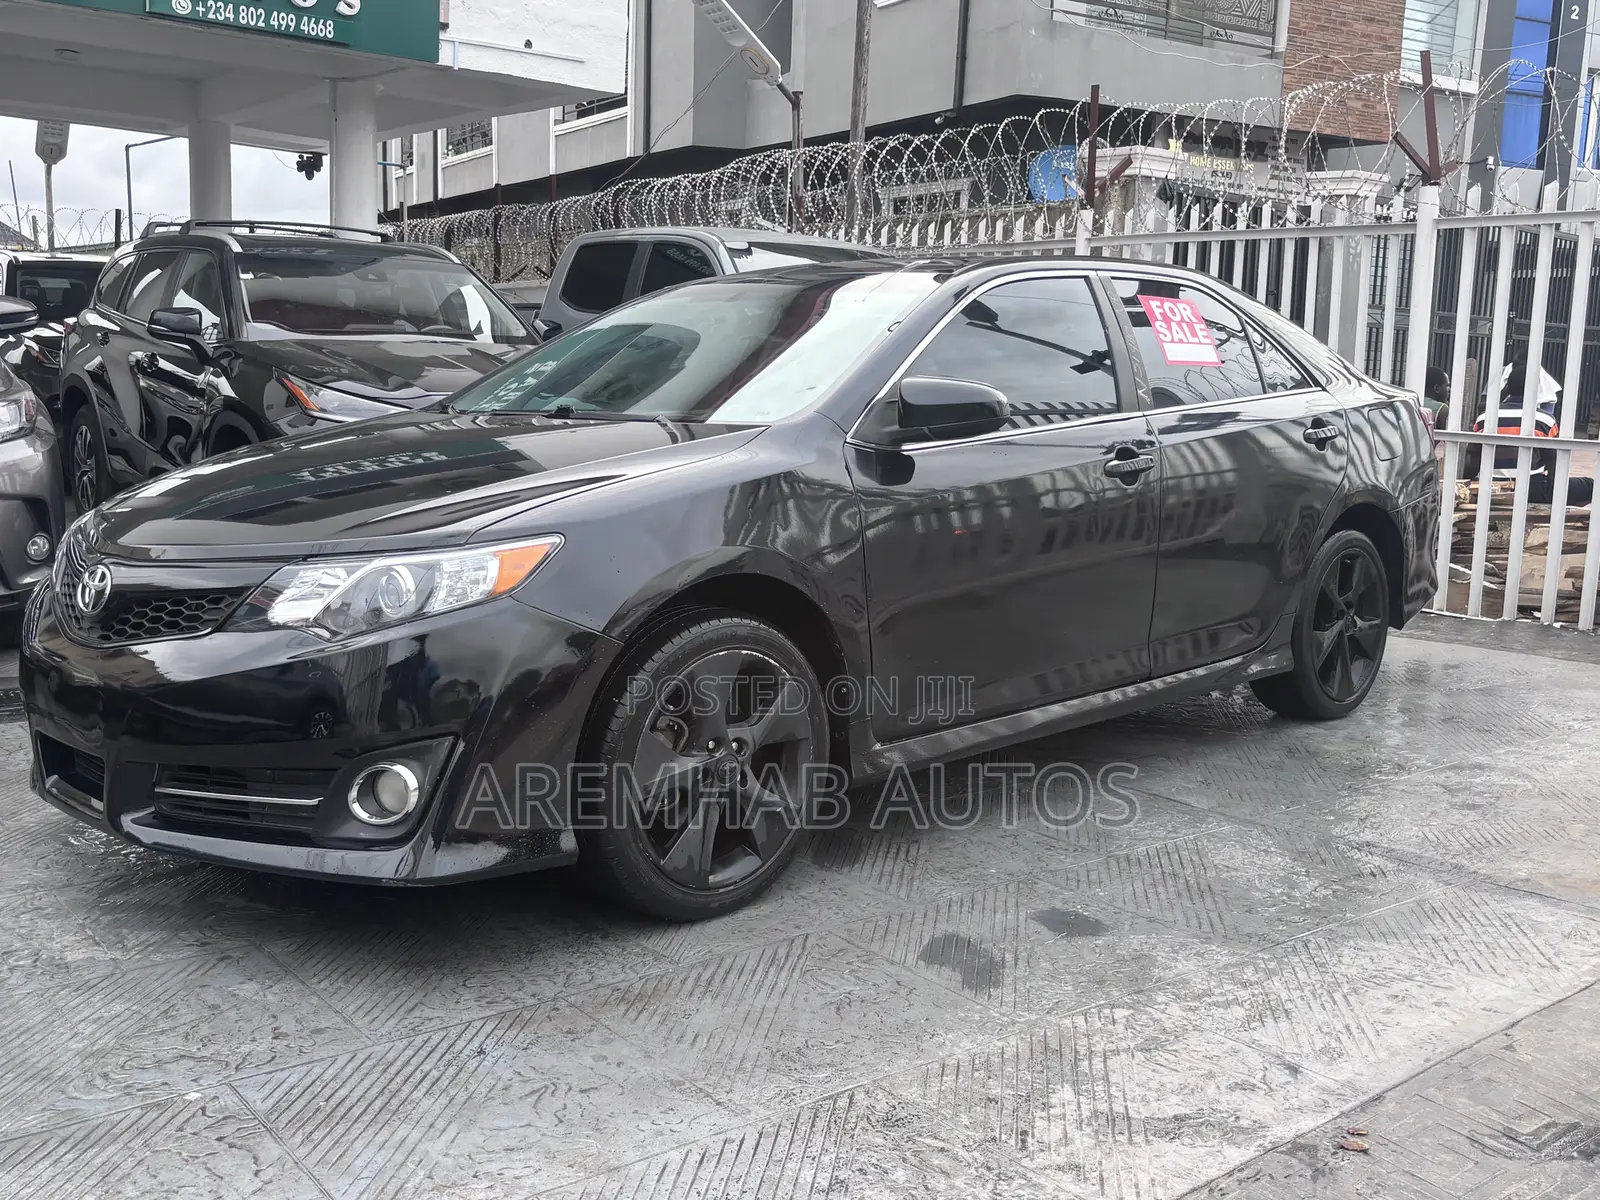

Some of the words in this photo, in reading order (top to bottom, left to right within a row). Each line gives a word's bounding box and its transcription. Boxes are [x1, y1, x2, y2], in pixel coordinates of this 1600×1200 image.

[195, 0, 235, 23] +234
[239, 5, 266, 28] 802
[270, 11, 297, 32] 499
[300, 16, 335, 39] 4668
[1570, 5, 1580, 20] 2
[1189, 156, 1212, 168] HOME
[1148, 299, 1199, 323] FOR
[1155, 321, 1213, 345] SALE
